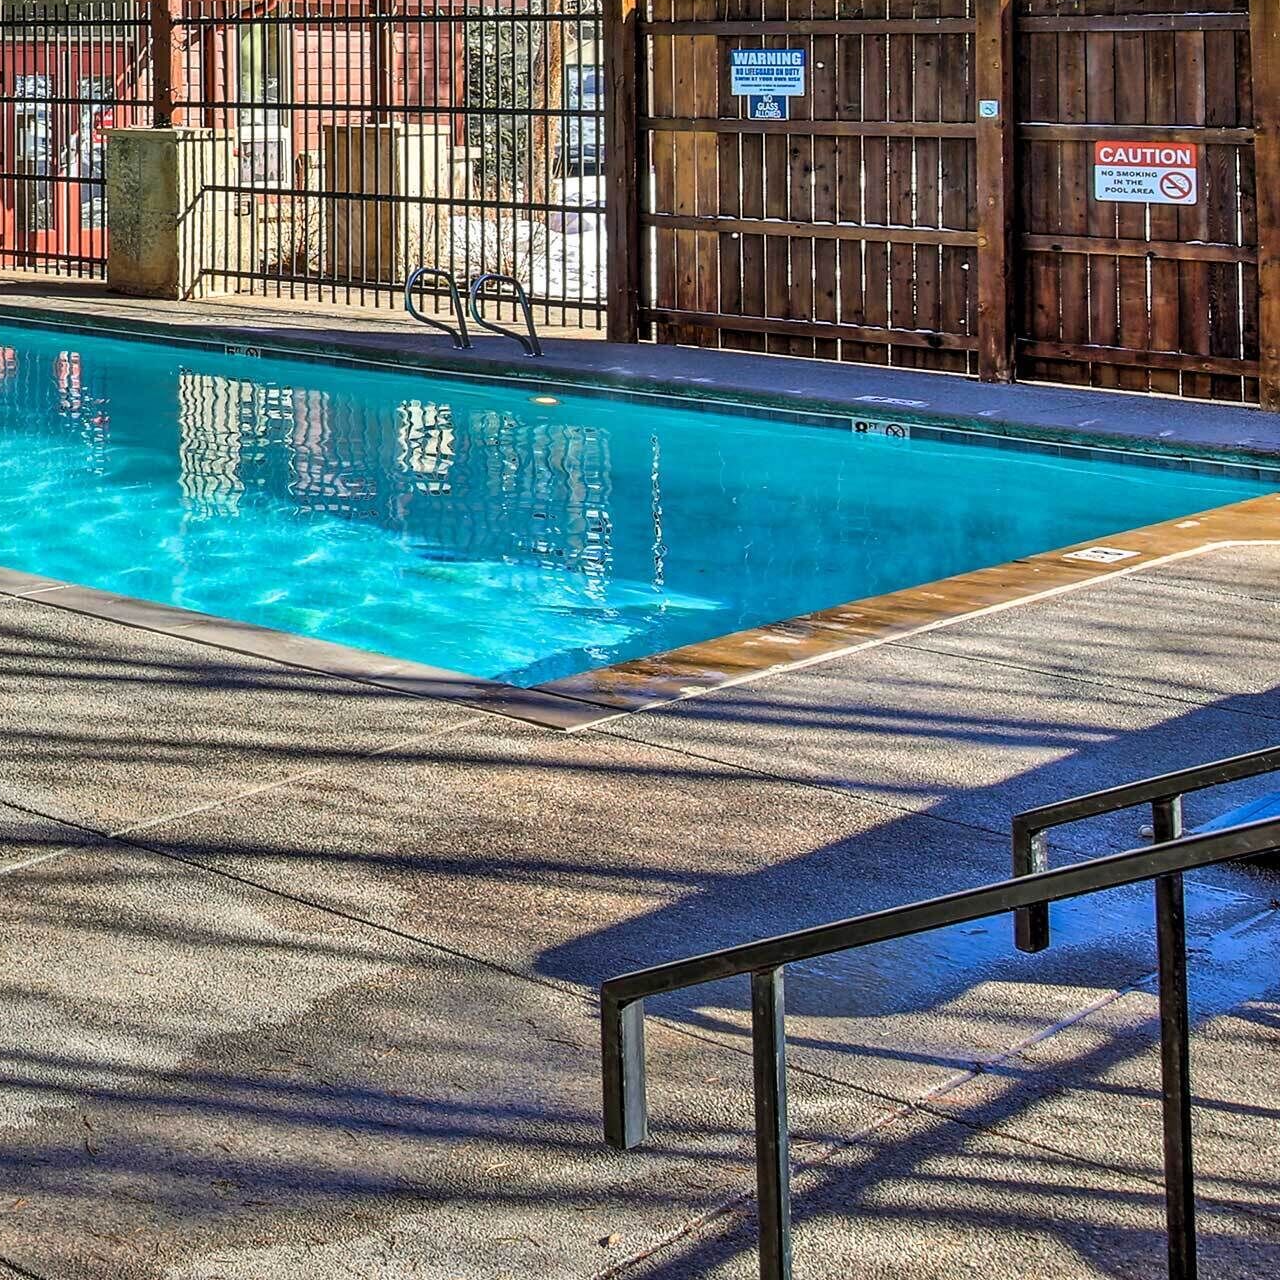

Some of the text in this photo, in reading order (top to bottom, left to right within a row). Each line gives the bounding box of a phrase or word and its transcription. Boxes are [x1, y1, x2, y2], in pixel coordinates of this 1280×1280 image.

[733, 52, 801, 65] WARNING
[755, 110, 781, 118] ALLOWED
[1100, 147, 1190, 164] CAUTION
